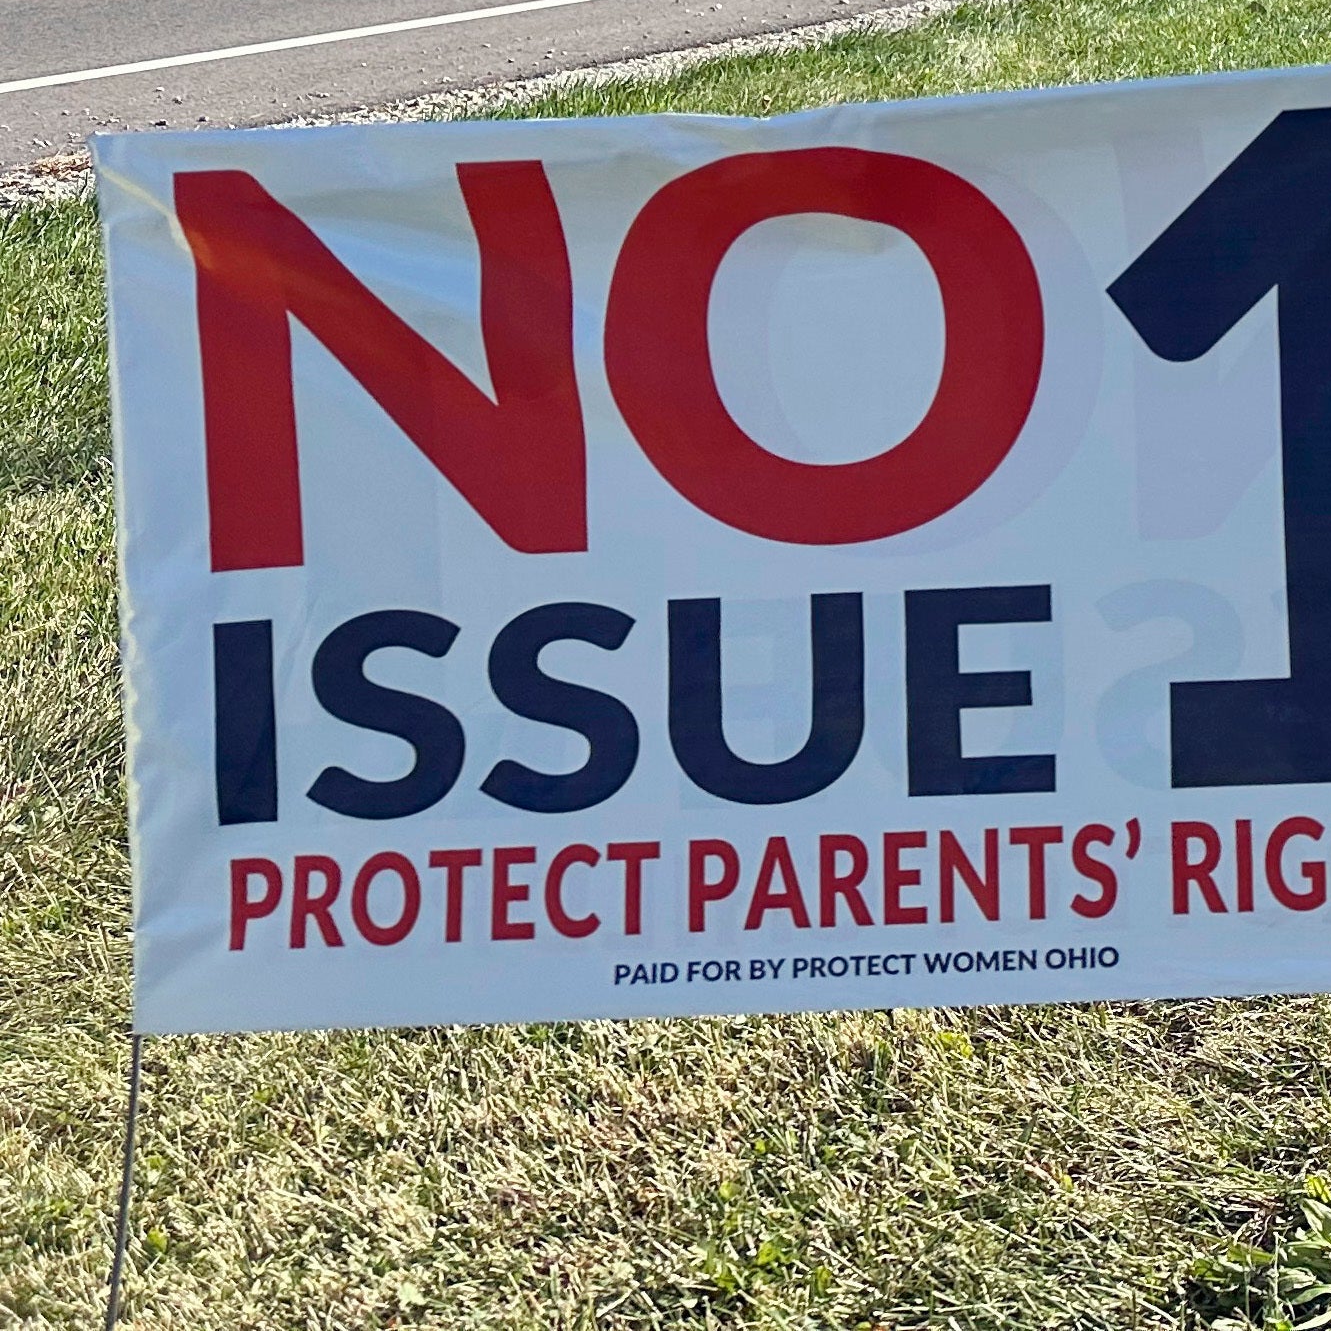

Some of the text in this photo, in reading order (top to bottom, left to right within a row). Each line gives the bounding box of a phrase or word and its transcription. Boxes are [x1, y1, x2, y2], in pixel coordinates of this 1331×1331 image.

[173, 145, 1044, 572] NO
[212, 584, 1058, 826] ISSUE
[227, 841, 661, 952] PROTECT
[613, 947, 1119, 986] PAID FOR BY PROTECT WOMEN OHIO
